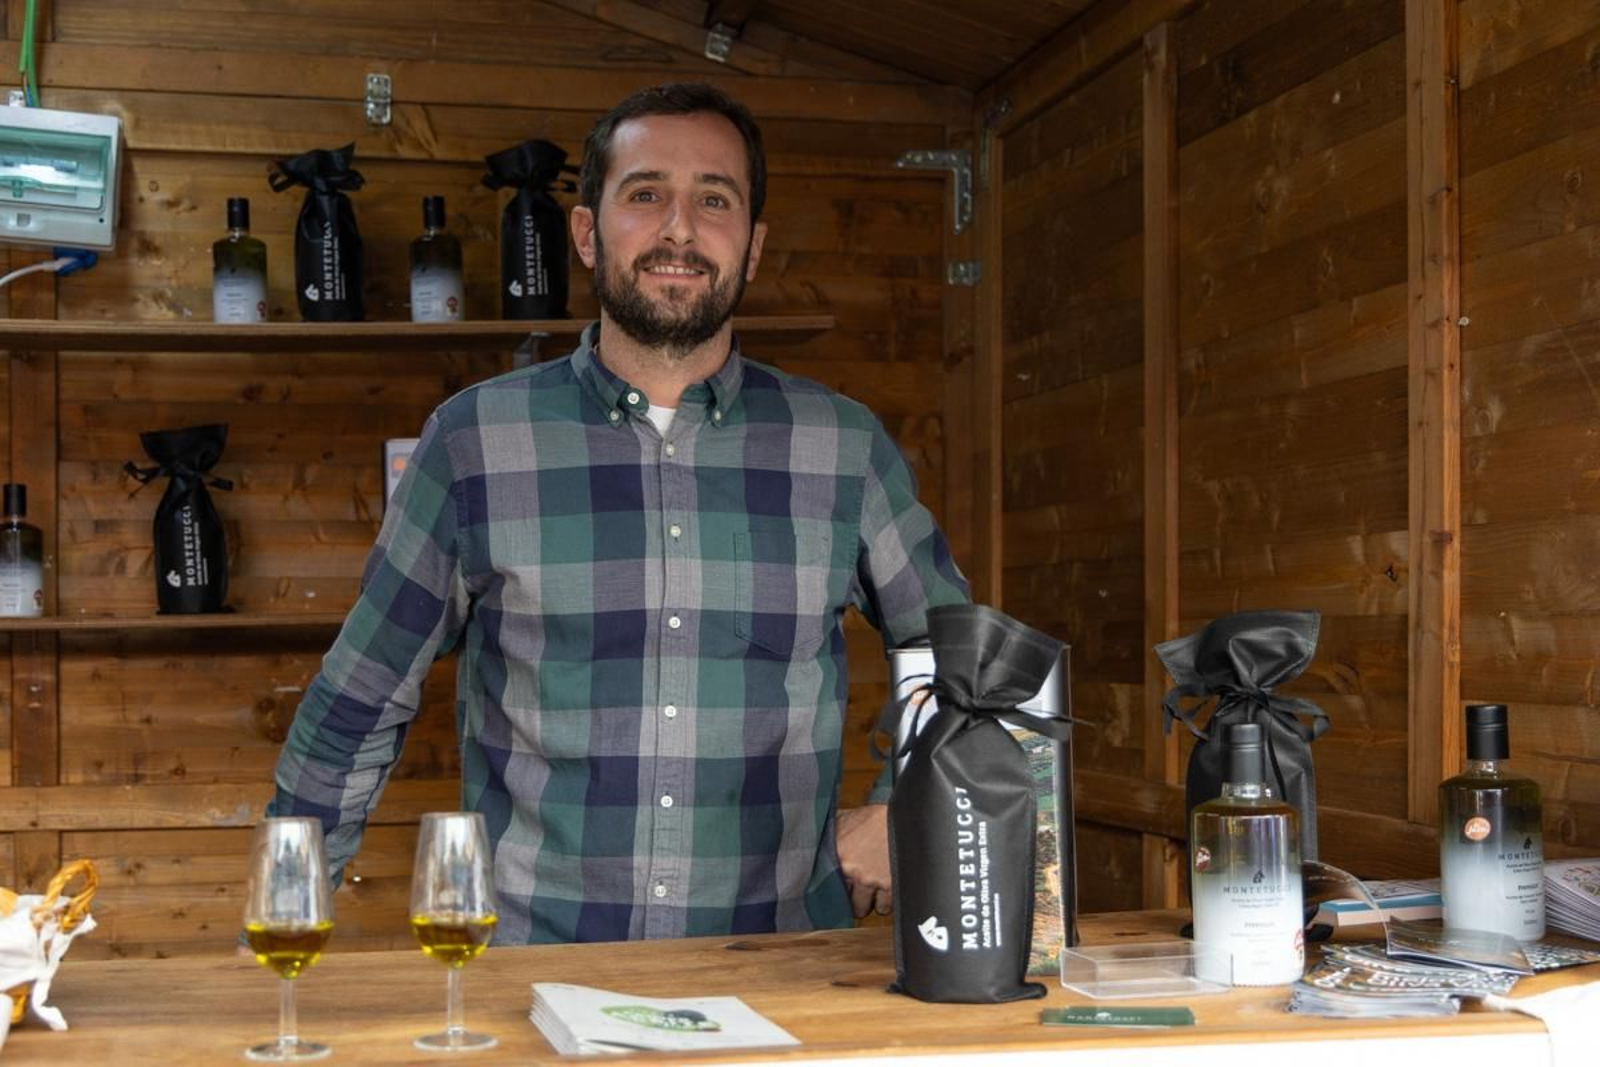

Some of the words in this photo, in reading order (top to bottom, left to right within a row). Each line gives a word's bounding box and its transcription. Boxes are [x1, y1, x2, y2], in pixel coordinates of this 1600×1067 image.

[182, 505, 196, 586] MONTETUCCI
[978, 821, 987, 845] Extra
[955, 787, 979, 949] MONTETUCCI
[979, 847, 991, 878] Virgen
[980, 879, 990, 903] Oliva
[981, 905, 990, 917] de
[982, 918, 991, 948] Aceite
